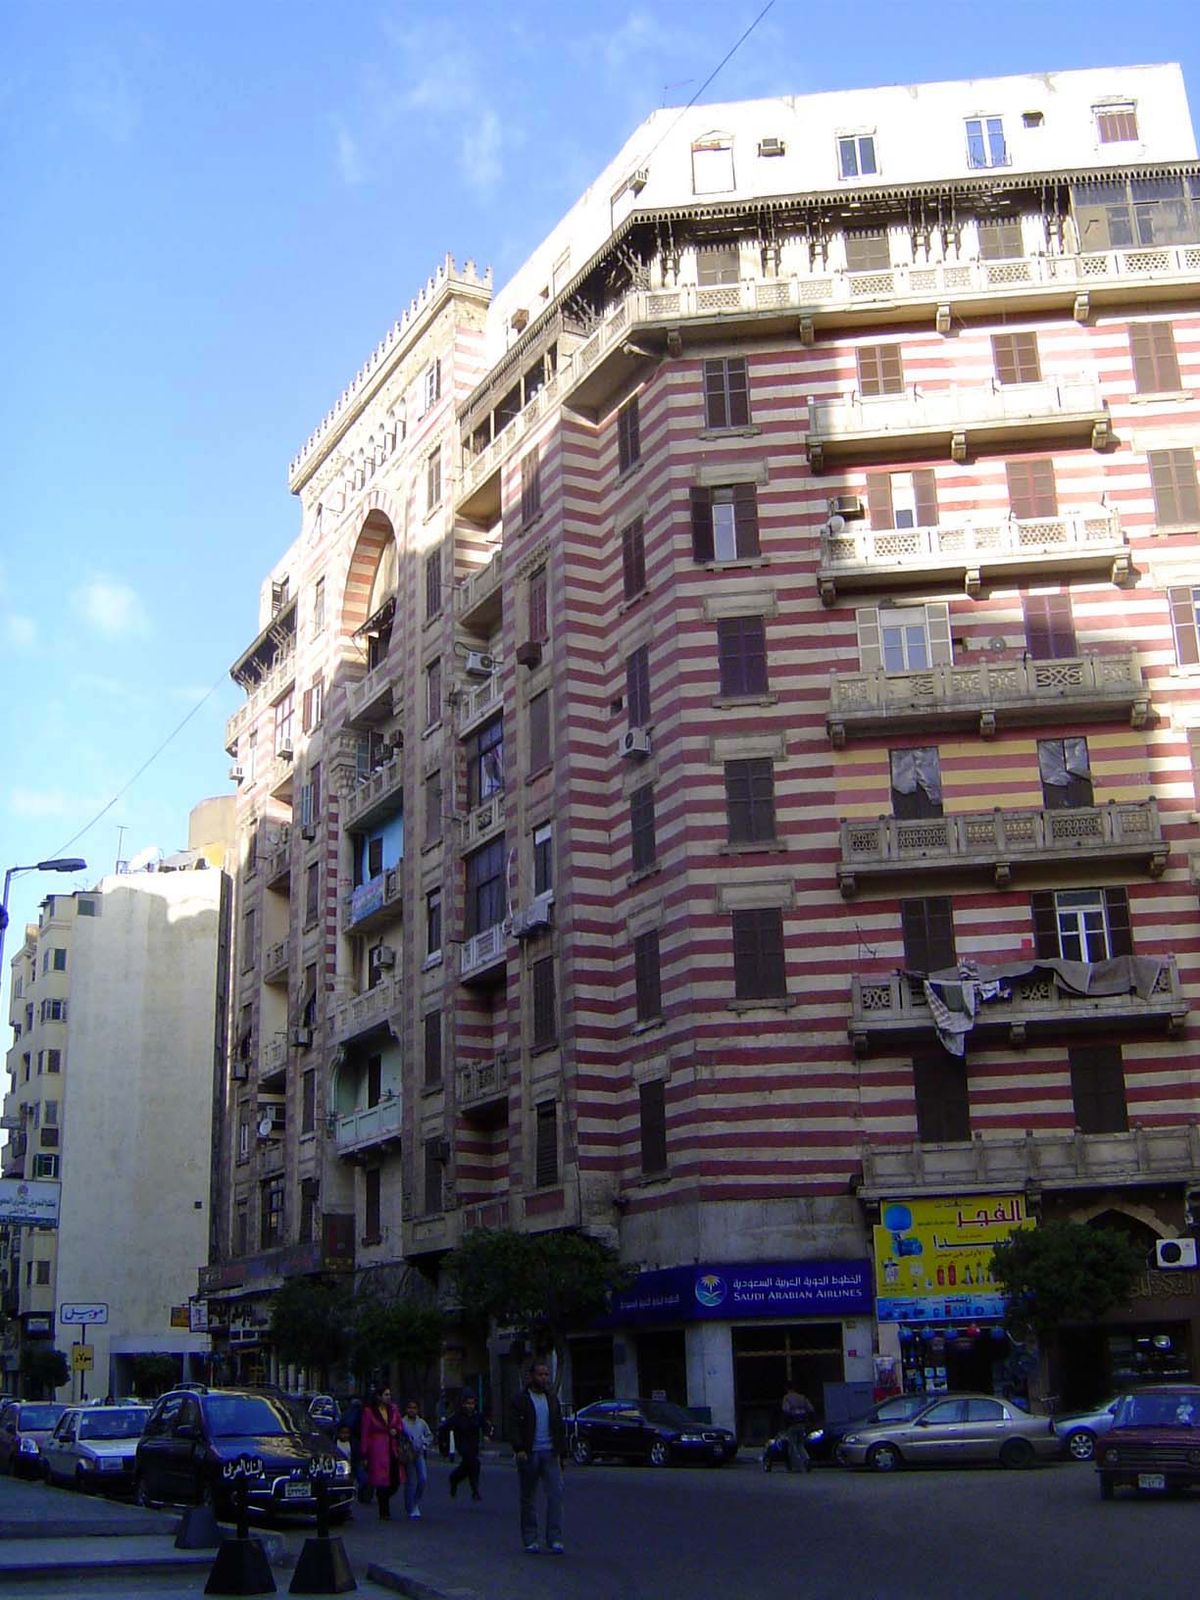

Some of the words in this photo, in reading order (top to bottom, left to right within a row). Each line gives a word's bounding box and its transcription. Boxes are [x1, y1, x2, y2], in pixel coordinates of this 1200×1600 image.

[957, 1199, 1023, 1229] الفجر
[733, 1278, 773, 1290] السعودية
[831, 1274, 863, 1287] الخطوط
[734, 1292, 765, 1302] SAUDI
[768, 1290, 813, 1301] ARABIAN
[816, 1288, 863, 1299] AIRLINES
